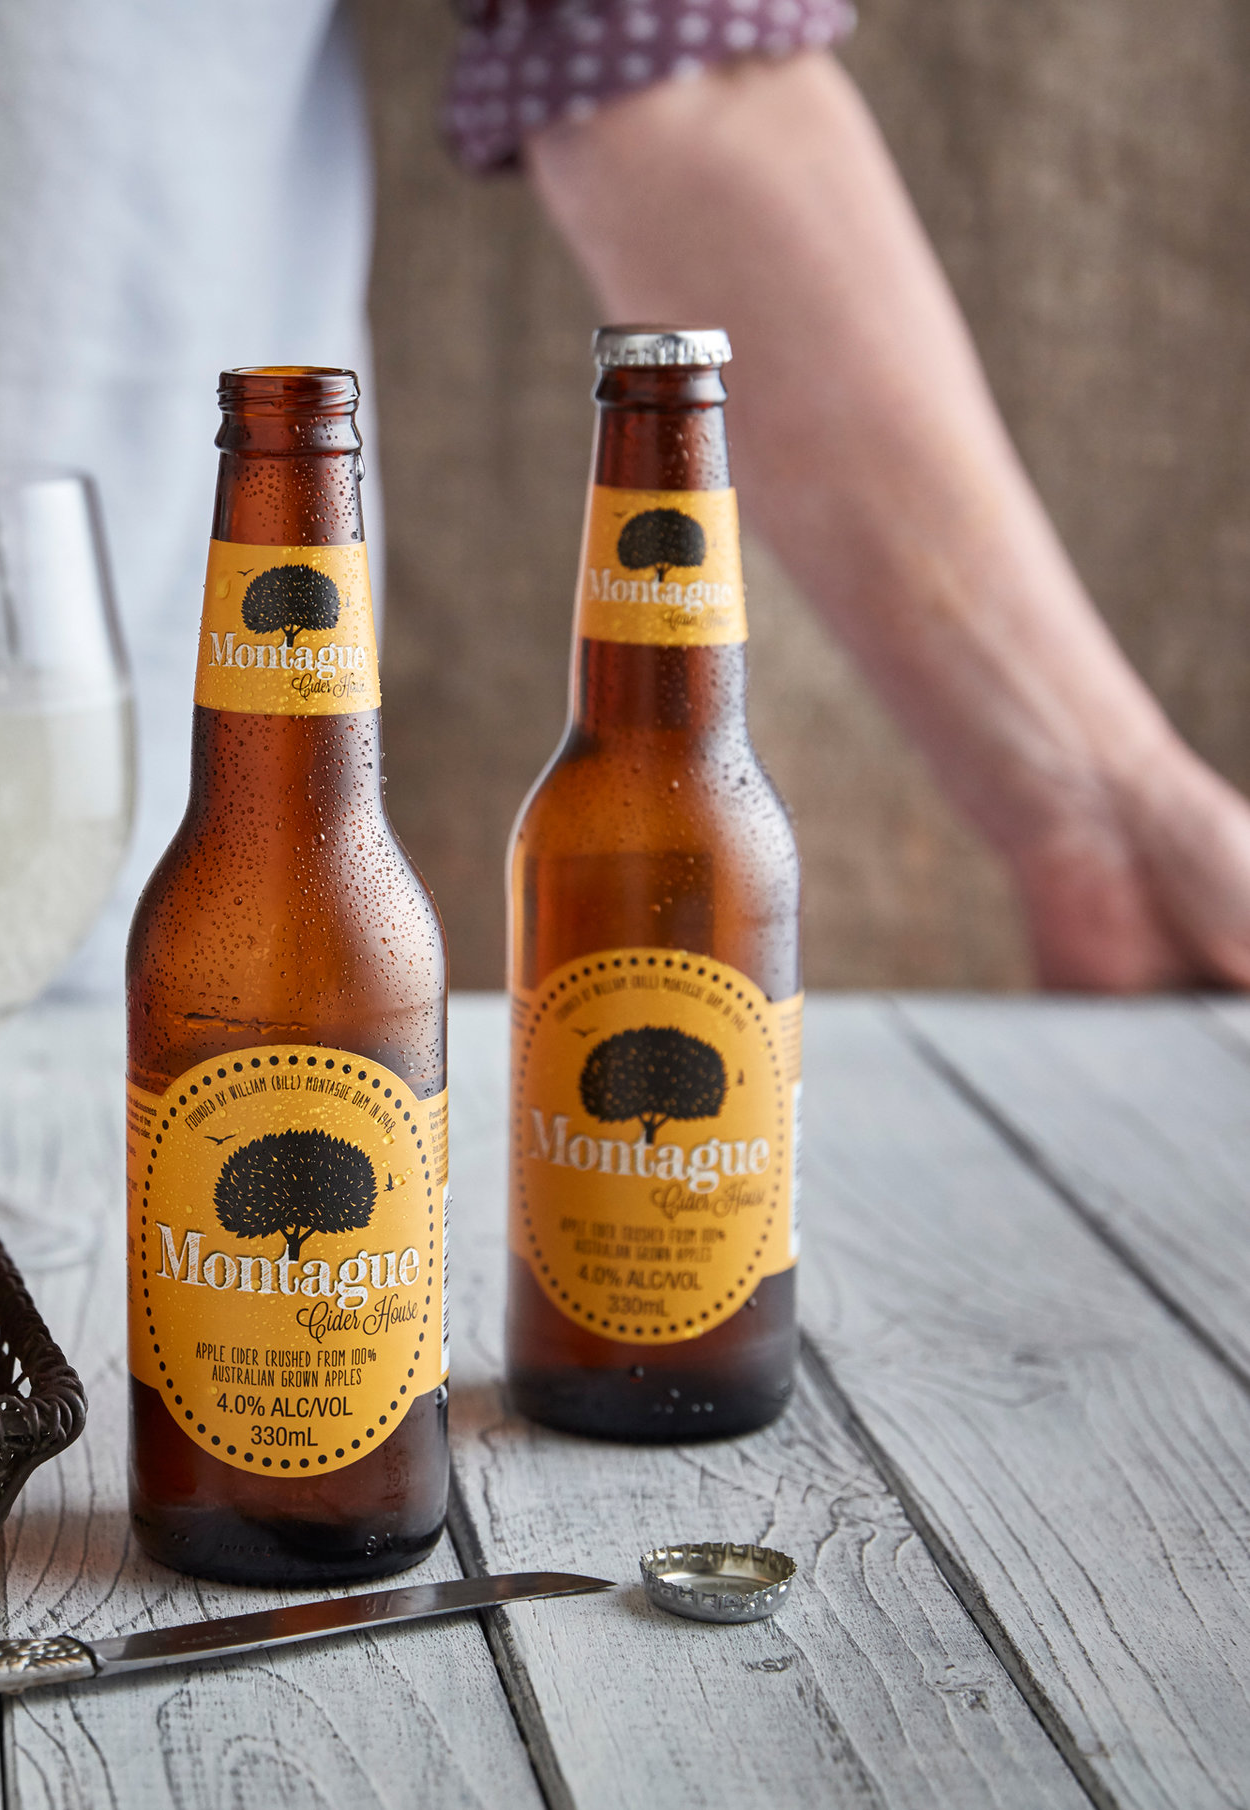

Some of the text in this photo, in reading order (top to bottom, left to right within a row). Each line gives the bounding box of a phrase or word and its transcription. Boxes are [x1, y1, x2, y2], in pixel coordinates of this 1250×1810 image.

[588, 568, 733, 616] Montague
[208, 632, 367, 681] Montague
[291, 673, 332, 701] Cider
[184, 1098, 217, 1132] FOUNDED
[214, 1090, 228, 1108] BY
[228, 1077, 268, 1101] WILLIAM
[271, 1075, 301, 1092] (BILL)
[305, 1076, 353, 1101] MONTAGUE
[368, 1102, 382, 1119] IN
[376, 1110, 397, 1134] 1948
[529, 1109, 770, 1194] Montague
[155, 1222, 421, 1311] Montague
[577, 1264, 703, 1292] 4.0% ALC/VOL
[296, 1292, 419, 1344] Cider House
[607, 1294, 670, 1318] 330mL
[195, 1341, 377, 1368] APPLE CIDER CRUSHED FROM 100%
[212, 1364, 362, 1388] AUSTRALIAN GROWN APPLES
[216, 1392, 353, 1418] 4.0% ALC/VOL
[250, 1425, 319, 1447] 330mL
